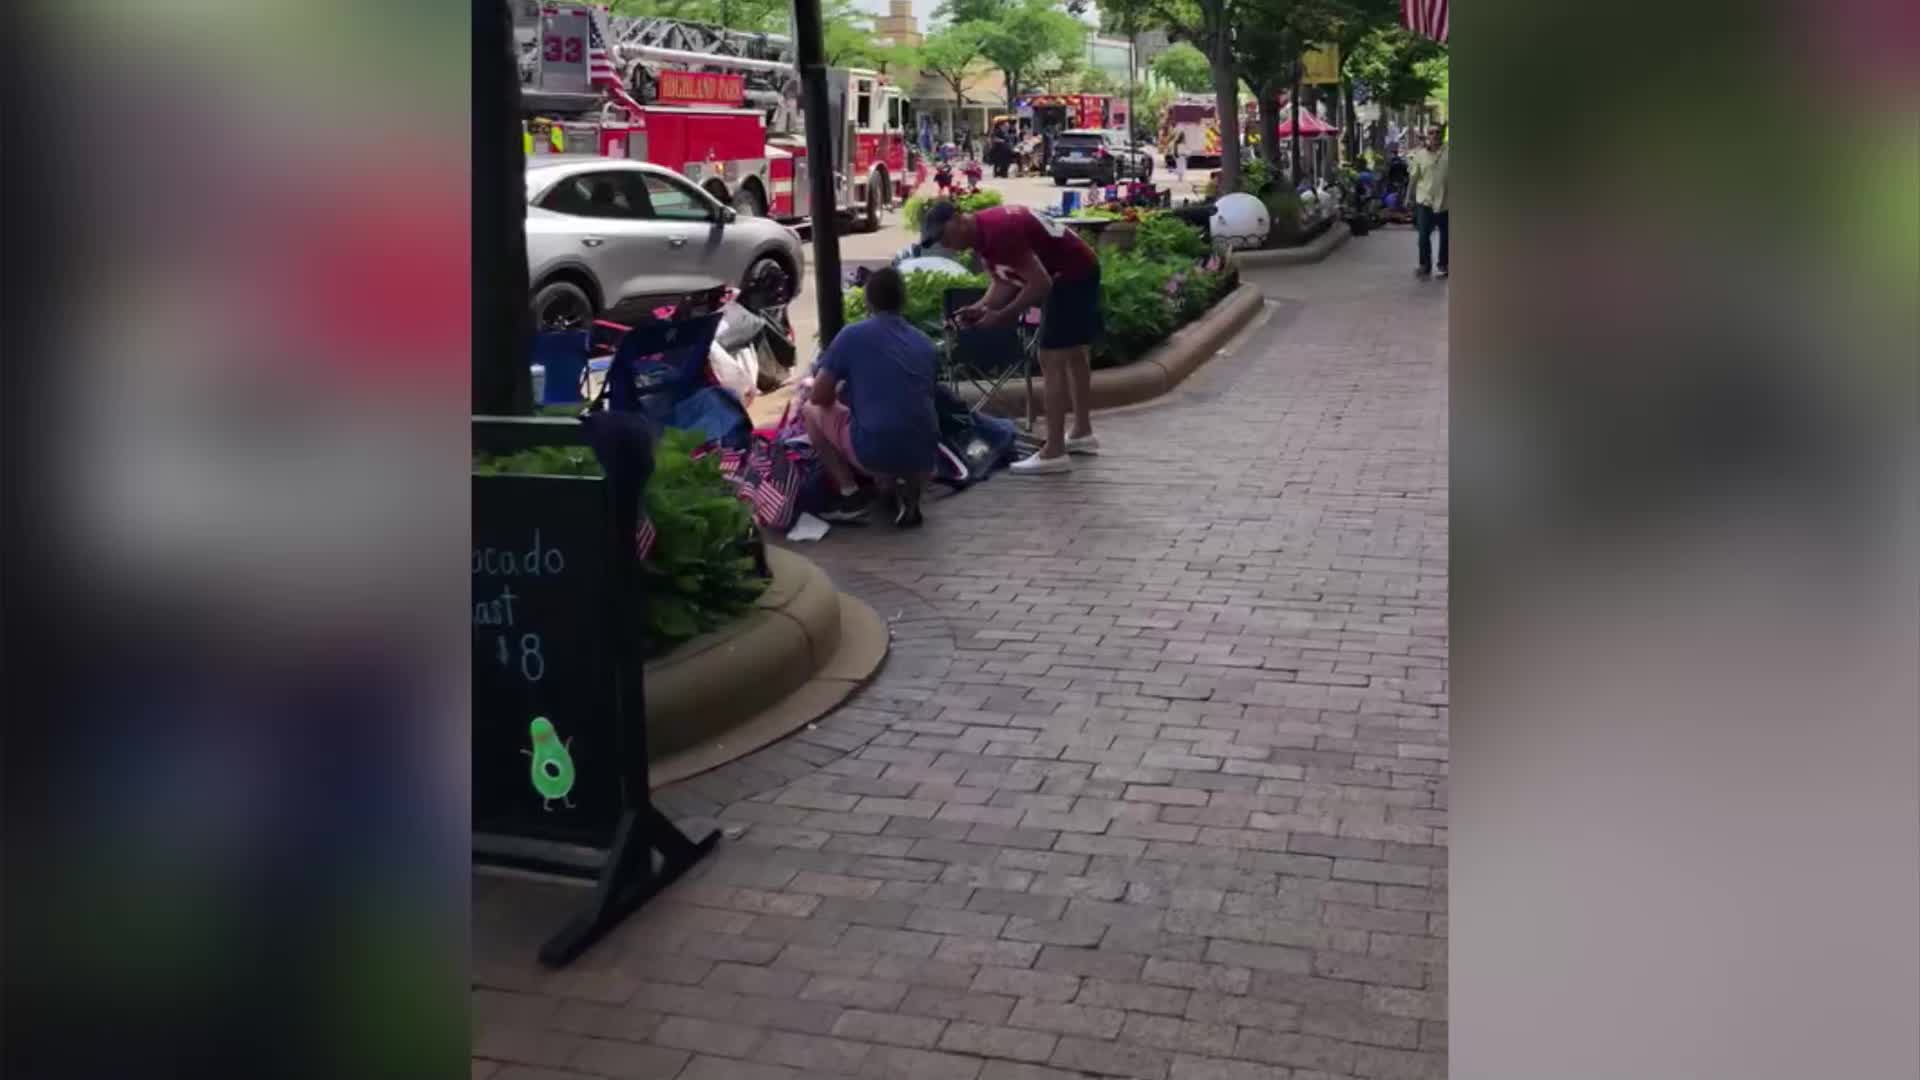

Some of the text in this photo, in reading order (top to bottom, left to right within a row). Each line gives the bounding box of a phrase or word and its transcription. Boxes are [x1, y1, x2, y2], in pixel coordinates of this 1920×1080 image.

[543, 36, 583, 63] 33
[662, 73, 742, 101] HIGHLAND PARK
